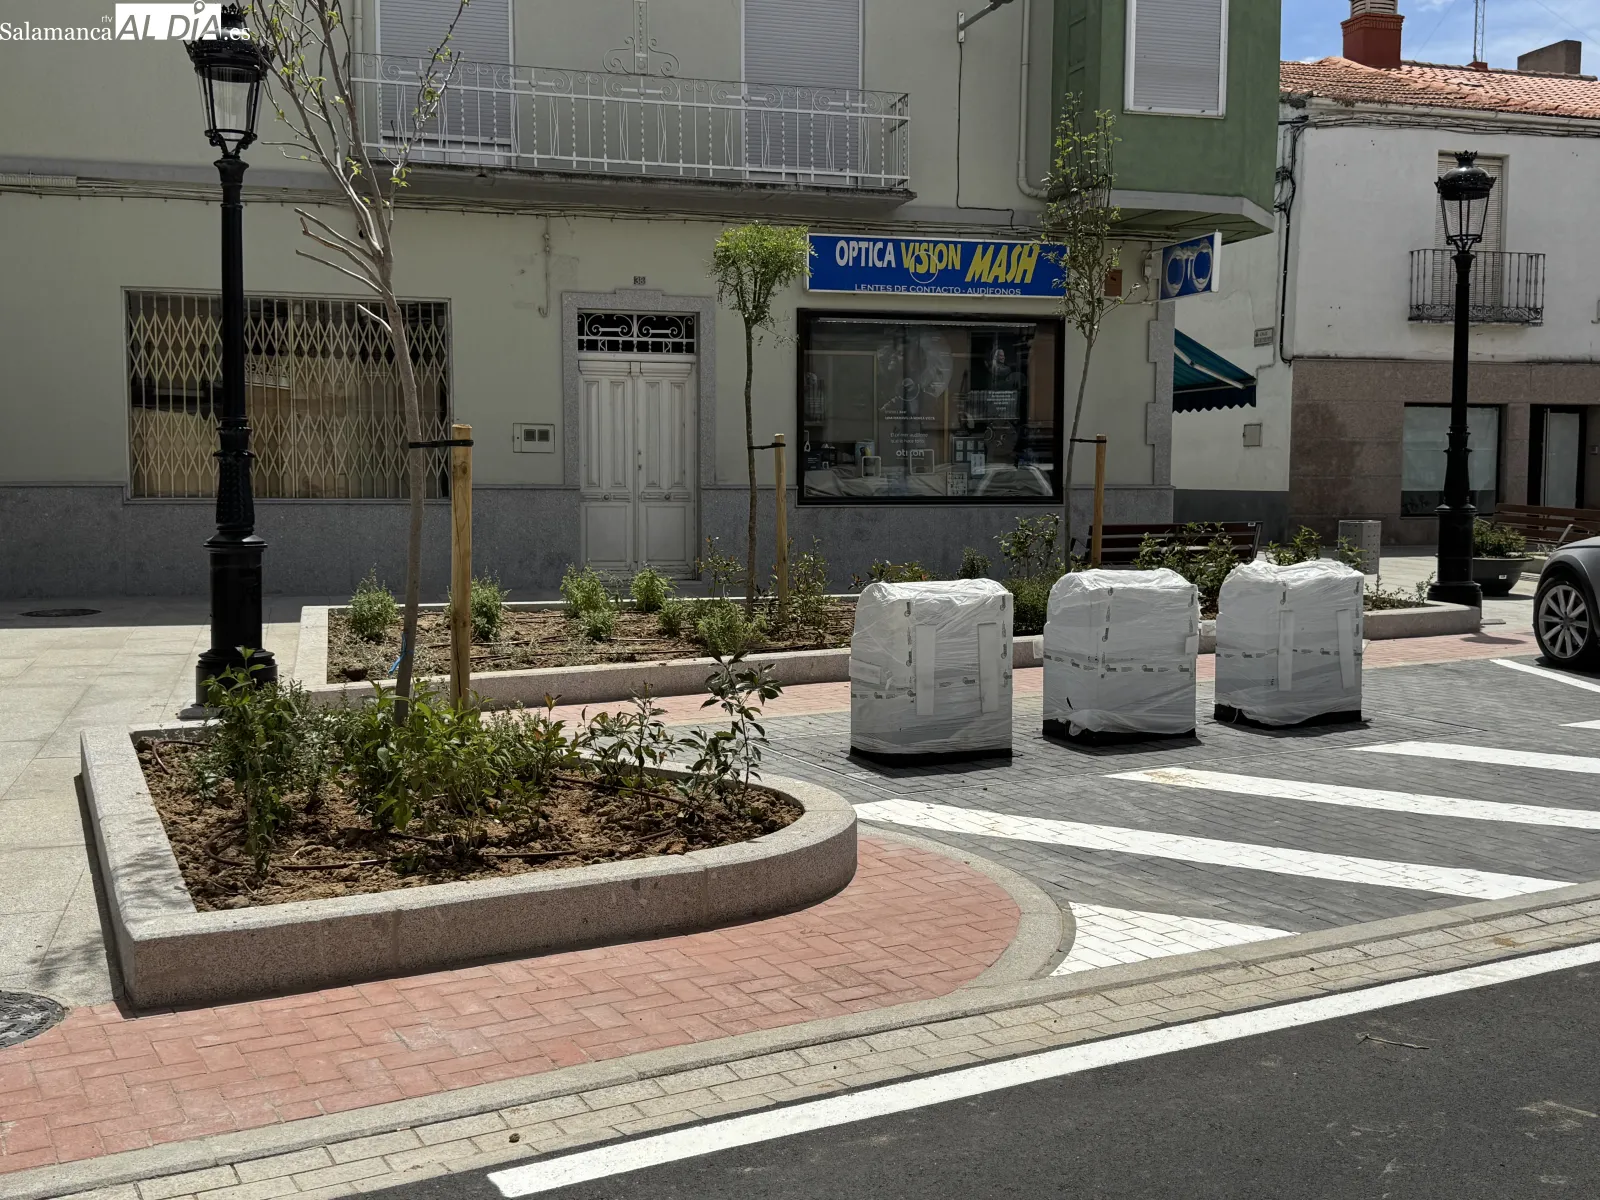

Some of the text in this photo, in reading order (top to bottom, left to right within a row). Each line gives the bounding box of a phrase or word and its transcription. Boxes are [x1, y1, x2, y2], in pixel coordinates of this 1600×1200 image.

[835, 239, 1041, 284] OPTICA VISION MASH
[855, 284, 893, 292] LENTES
[894, 285, 907, 293] DE
[909, 285, 961, 294] CONTACTO
